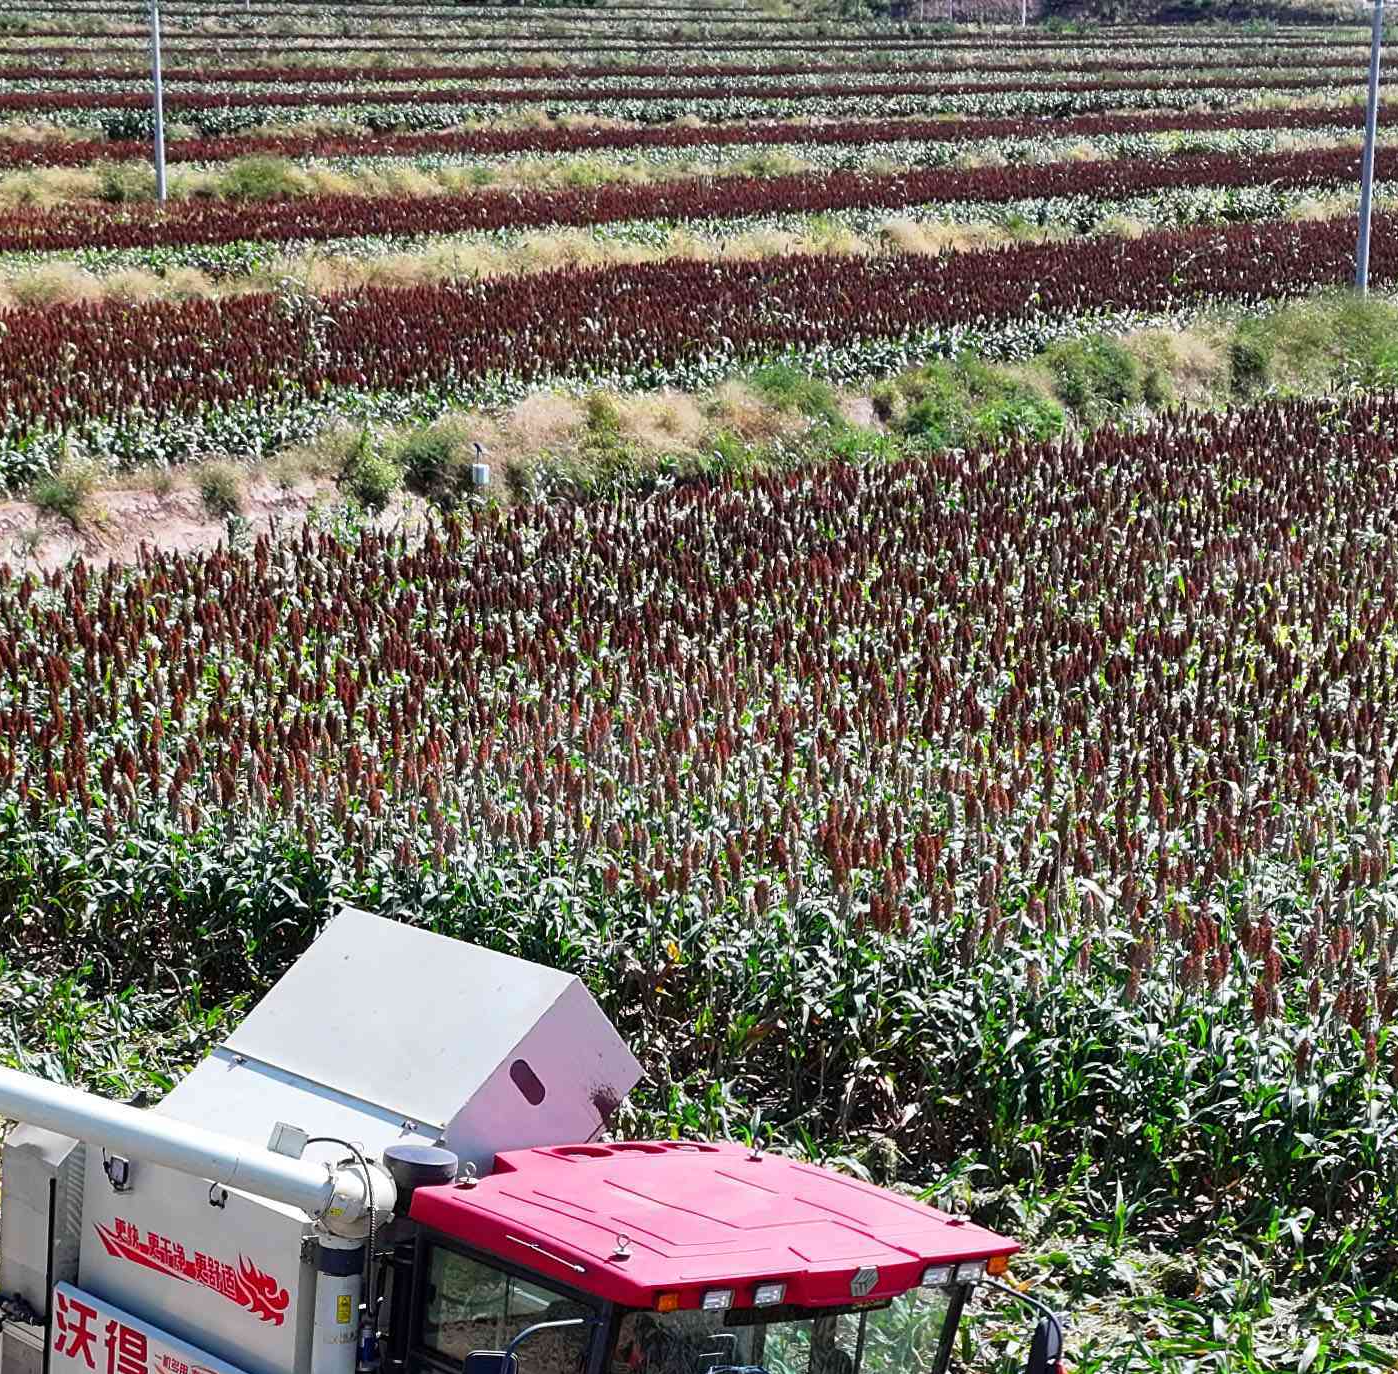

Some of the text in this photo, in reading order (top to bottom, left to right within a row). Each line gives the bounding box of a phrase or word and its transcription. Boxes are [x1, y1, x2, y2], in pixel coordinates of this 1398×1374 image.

[114, 1217, 237, 1299] 更快 更干净 更舒适
